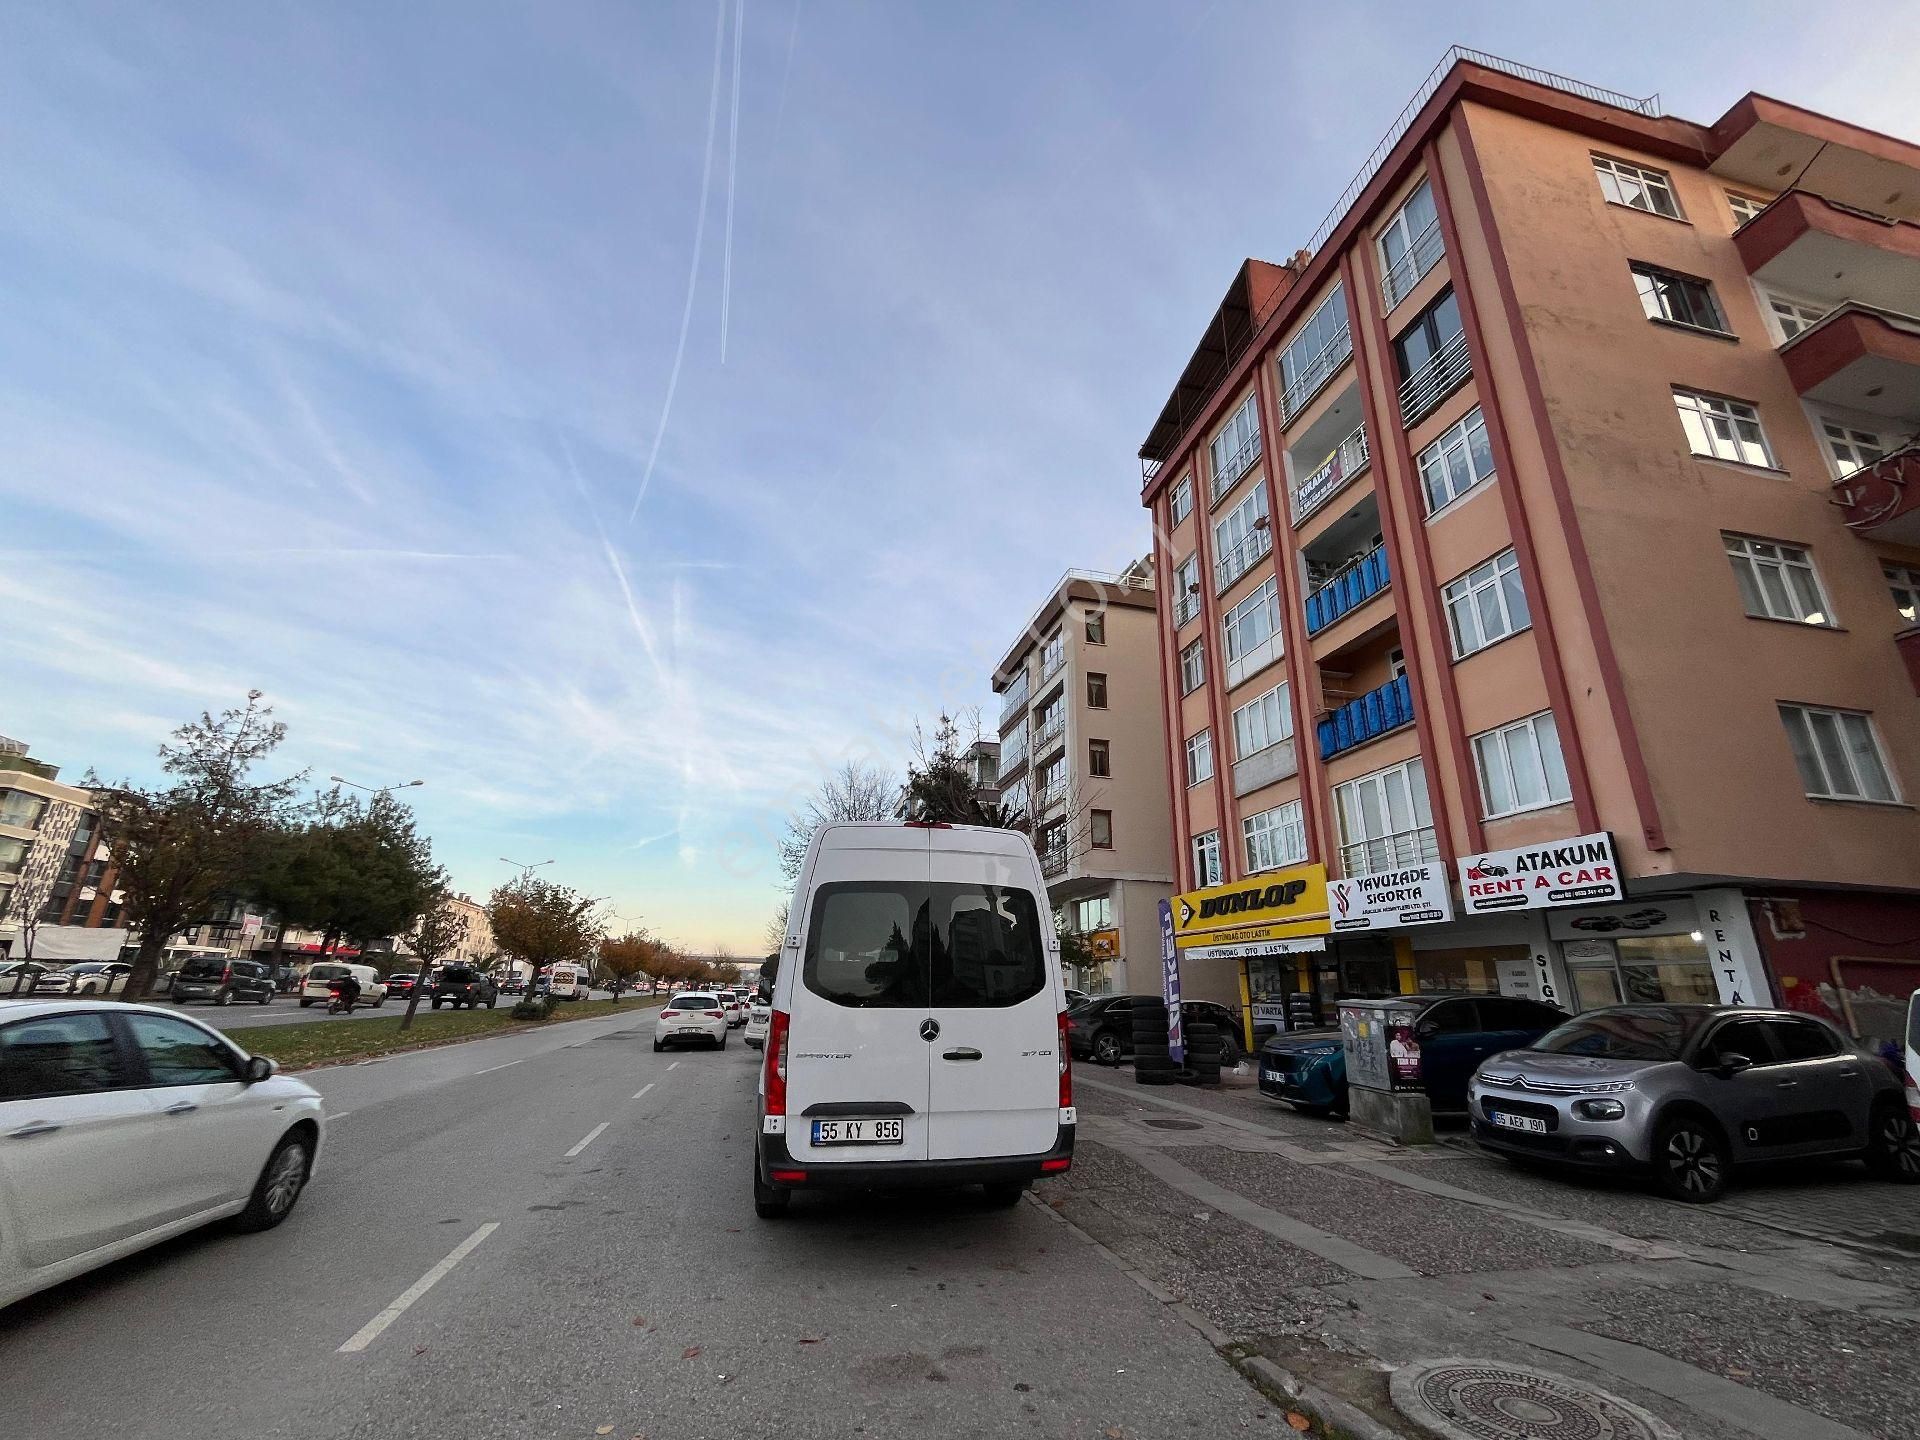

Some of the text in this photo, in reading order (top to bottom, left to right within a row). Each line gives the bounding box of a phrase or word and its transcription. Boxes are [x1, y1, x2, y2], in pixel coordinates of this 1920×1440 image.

[1516, 842, 1608, 873] ATAKUM
[1357, 868, 1430, 892] YAVUZADE
[1469, 866, 1613, 897] RENT A CAR
[1199, 880, 1306, 918] DUNLOP
[1240, 931, 1250, 940] OTO
[1709, 909, 1735, 983] RENT
[1245, 947, 1258, 955] OTO
[1260, 1006, 1282, 1017] VARTA
[821, 1121, 899, 1140] 55 KY 856
[1495, 1113, 1544, 1132] 55 AER 190
